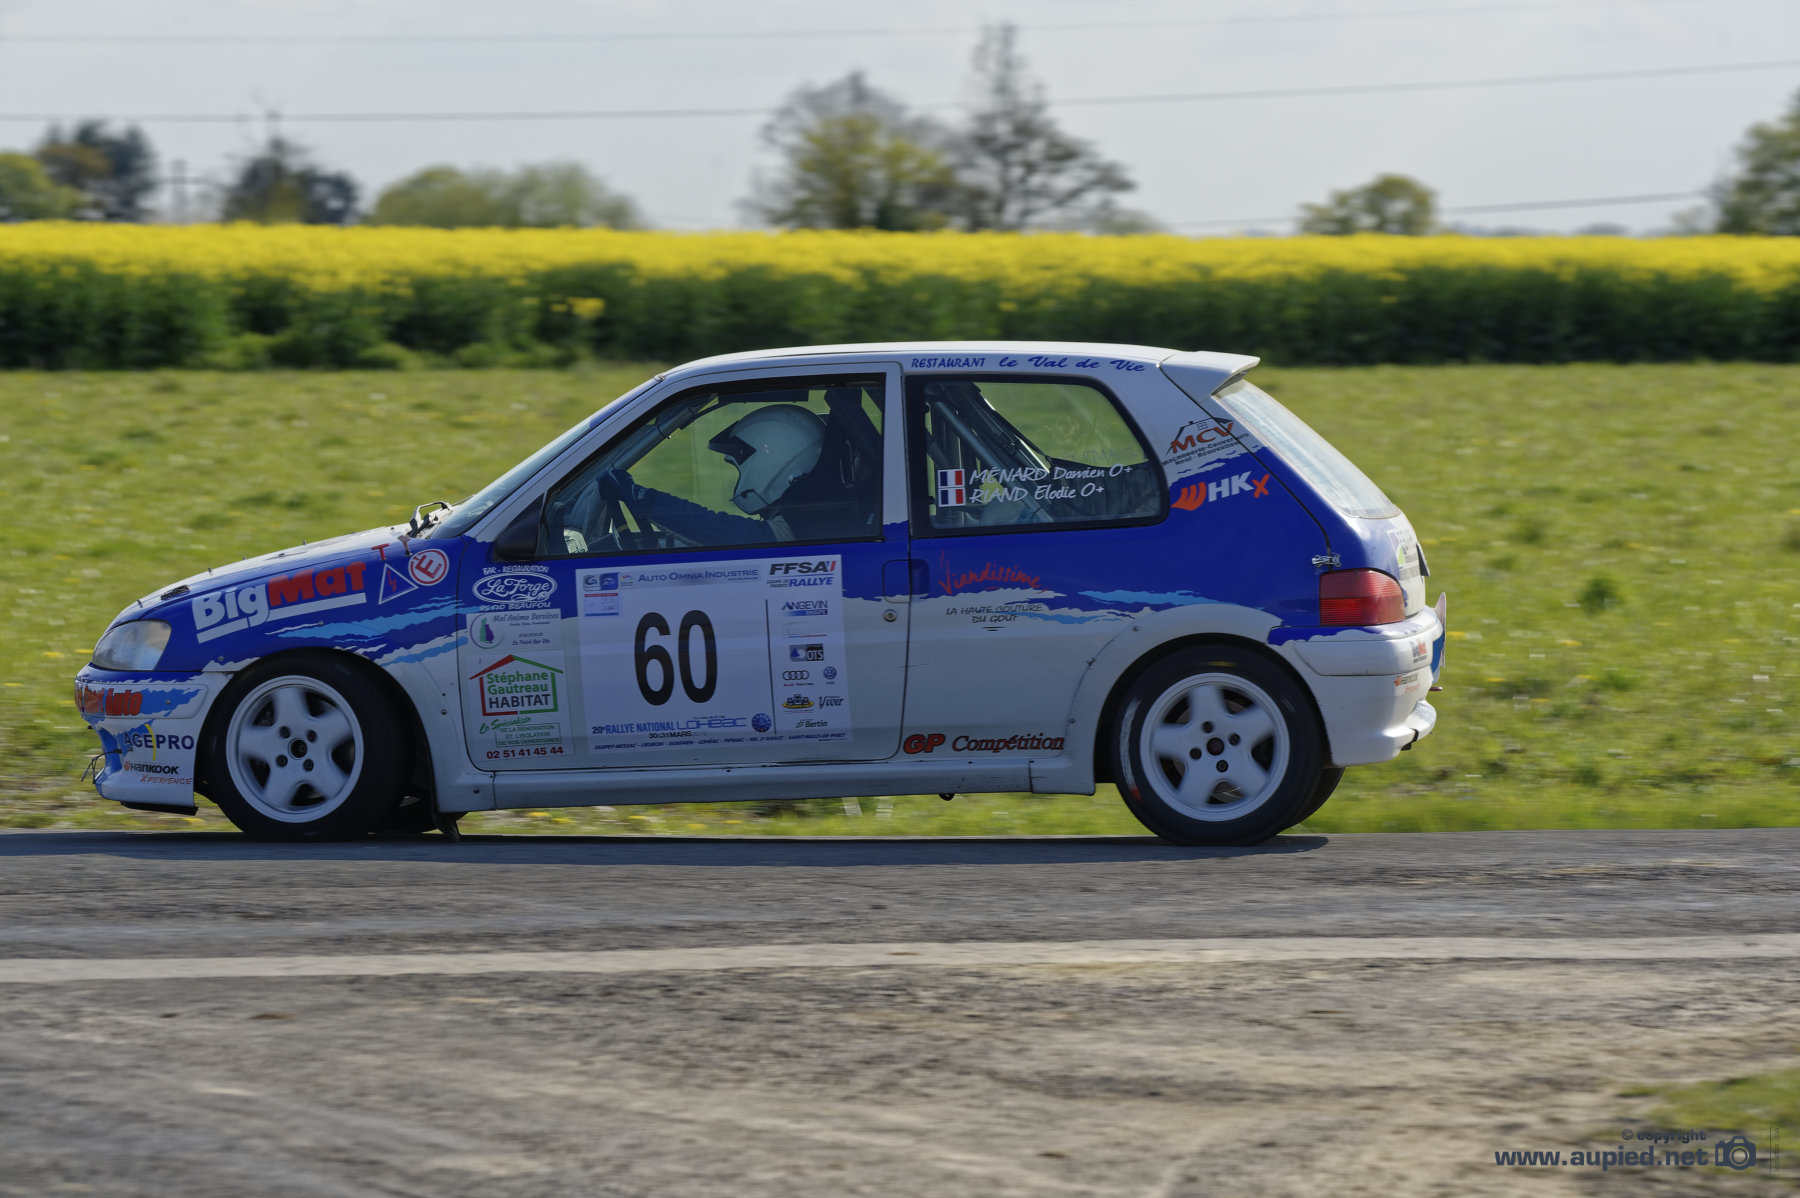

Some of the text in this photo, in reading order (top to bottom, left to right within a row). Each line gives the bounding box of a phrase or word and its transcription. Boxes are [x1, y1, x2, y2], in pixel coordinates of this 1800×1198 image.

[911, 355, 1144, 371] RESTAURANT le Val de Vie
[1170, 422, 1233, 454] MCV
[1053, 467, 1105, 481] Damien
[372, 544, 389, 561] T
[769, 561, 828, 575] FFSA
[638, 573, 668, 582] AUTO
[704, 569, 759, 579] INDUSTRIE
[789, 577, 833, 587] RALLYE
[481, 578, 550, 597] La Forge
[781, 600, 828, 610] ANGEVIN
[946, 607, 958, 616] LA
[961, 605, 993, 615] HAUTE
[972, 615, 986, 623] DU
[635, 610, 718, 706] 60
[487, 671, 549, 685] Stéphane
[487, 683, 548, 695] Gautreau
[489, 694, 550, 708] HABITAT
[605, 723, 635, 735] RALLYE
[636, 720, 675, 733] NATIONAL
[903, 732, 1065, 755] GP Compétition
[486, 746, 564, 759] 02 51 41 45 44
